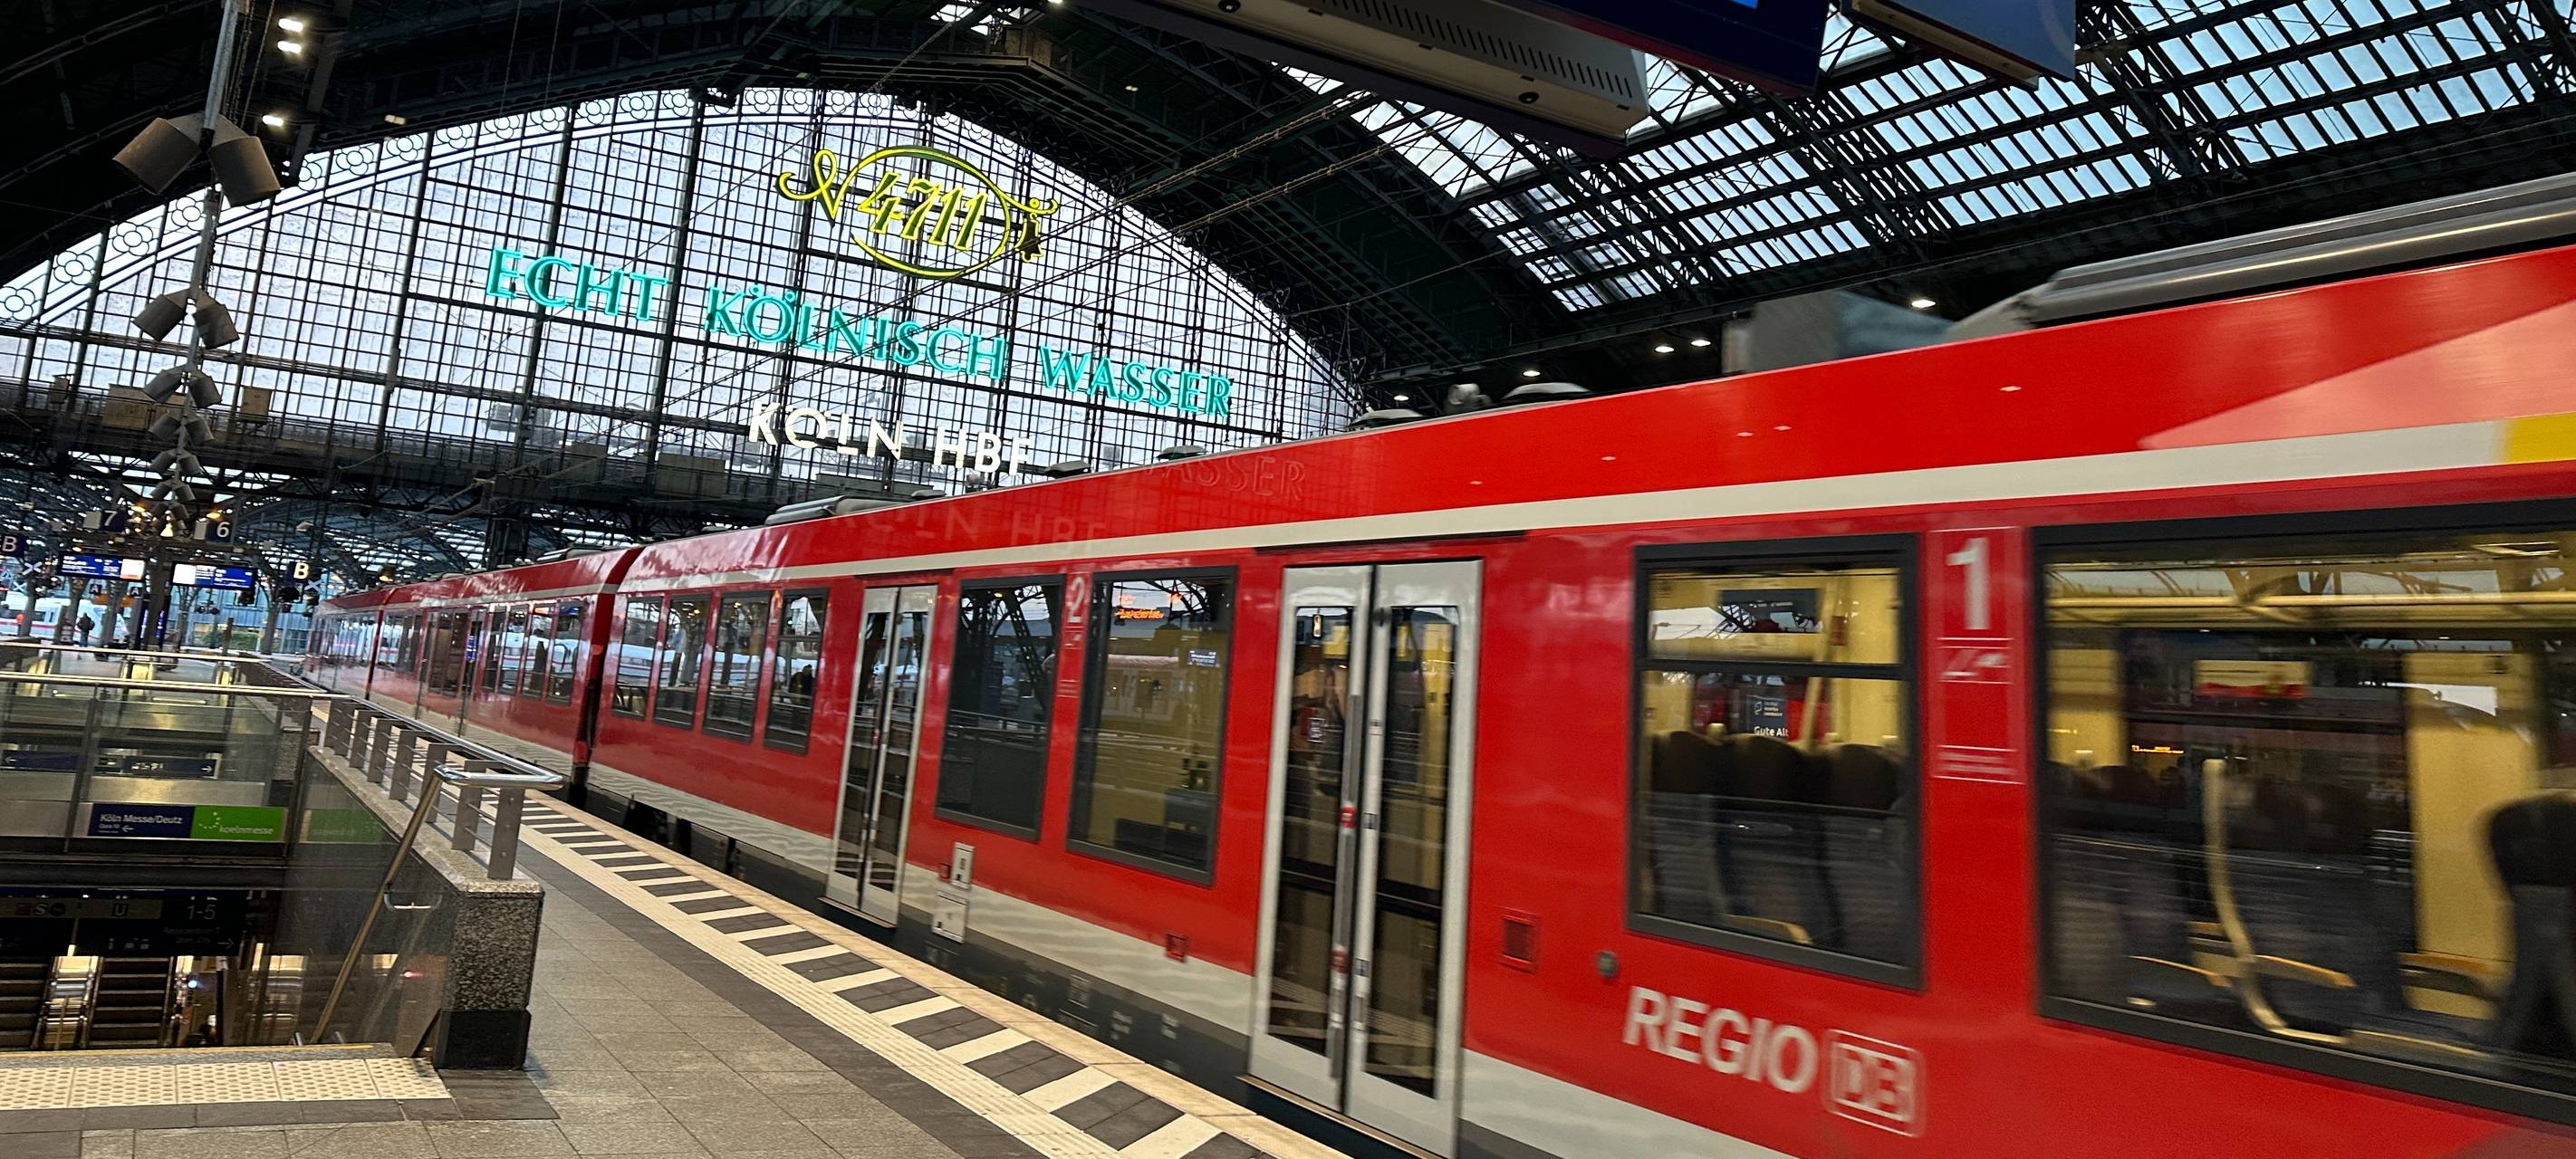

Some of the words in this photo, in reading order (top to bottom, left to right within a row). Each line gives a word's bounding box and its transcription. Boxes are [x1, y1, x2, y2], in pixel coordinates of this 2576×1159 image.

[856, 170, 989, 251] 4711
[485, 245, 668, 322] ECHT
[704, 283, 1008, 380] KÖLNISCH
[1038, 344, 1234, 417] WASSER
[748, 400, 905, 461] KÖLN
[933, 426, 1034, 476] HBF
[102, 510, 118, 527] 7
[216, 521, 231, 539] 6
[2, 535, 18, 552] B
[293, 562, 310, 580] B
[1946, 537, 1991, 630] 1
[1067, 576, 1086, 623] 2
[1754, 725, 1775, 736] Gute
[100, 813, 121, 822] Köln
[123, 814, 183, 824] Messe/Deutz
[114, 903, 128, 916] U
[187, 904, 216, 920] 1-5
[1622, 984, 1820, 1094] REGIO
[1827, 1039, 1921, 1126] DB
